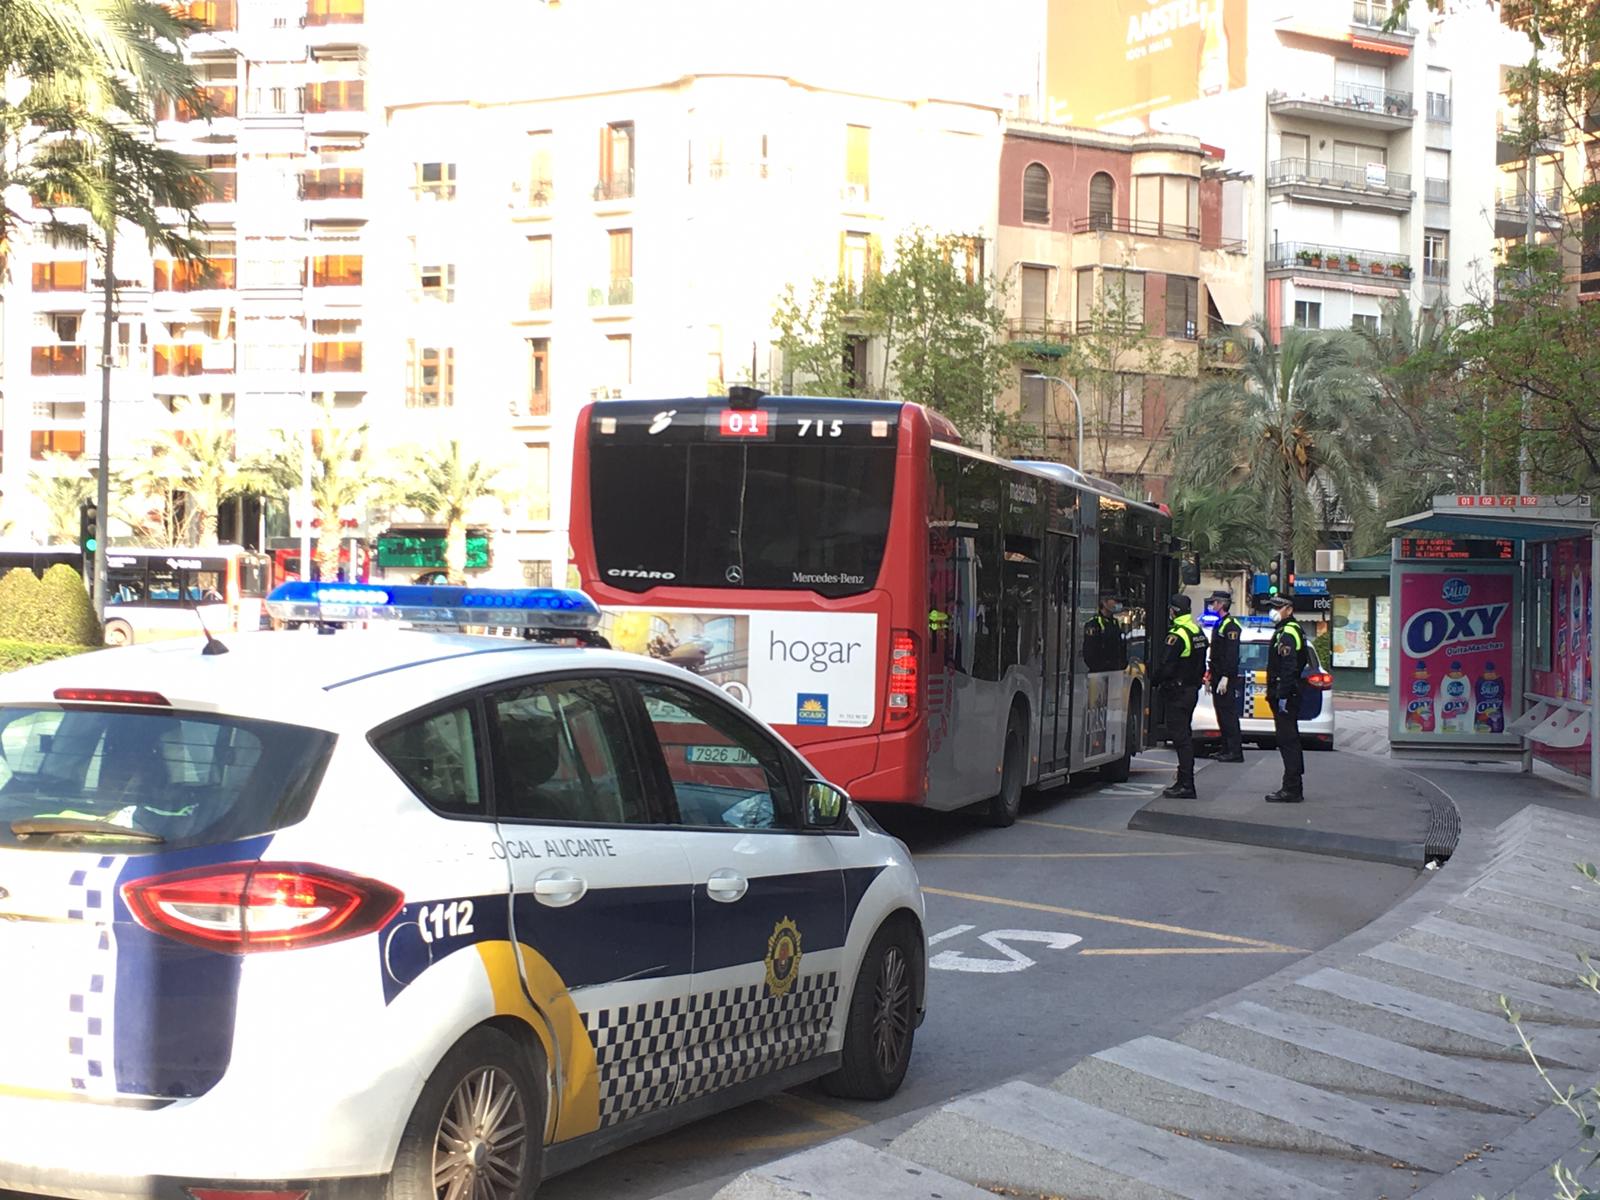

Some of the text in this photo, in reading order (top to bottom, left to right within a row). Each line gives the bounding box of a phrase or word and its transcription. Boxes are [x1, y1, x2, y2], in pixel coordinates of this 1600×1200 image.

[728, 413, 759, 433] 01
[797, 419, 843, 437] 715
[1461, 497, 1471, 505] 01
[1482, 497, 1493, 505] 02
[1522, 497, 1537, 505] 192
[607, 568, 676, 580] CITARO
[792, 571, 864, 585] Mercedes-Benz
[1403, 603, 1508, 657] OXY
[769, 630, 861, 673] hogar
[799, 710, 825, 720] OCASO
[696, 748, 728, 762] 7926
[489, 840, 541, 860] OCAL
[544, 838, 617, 858] ALICANTE
[429, 900, 474, 939] 112
